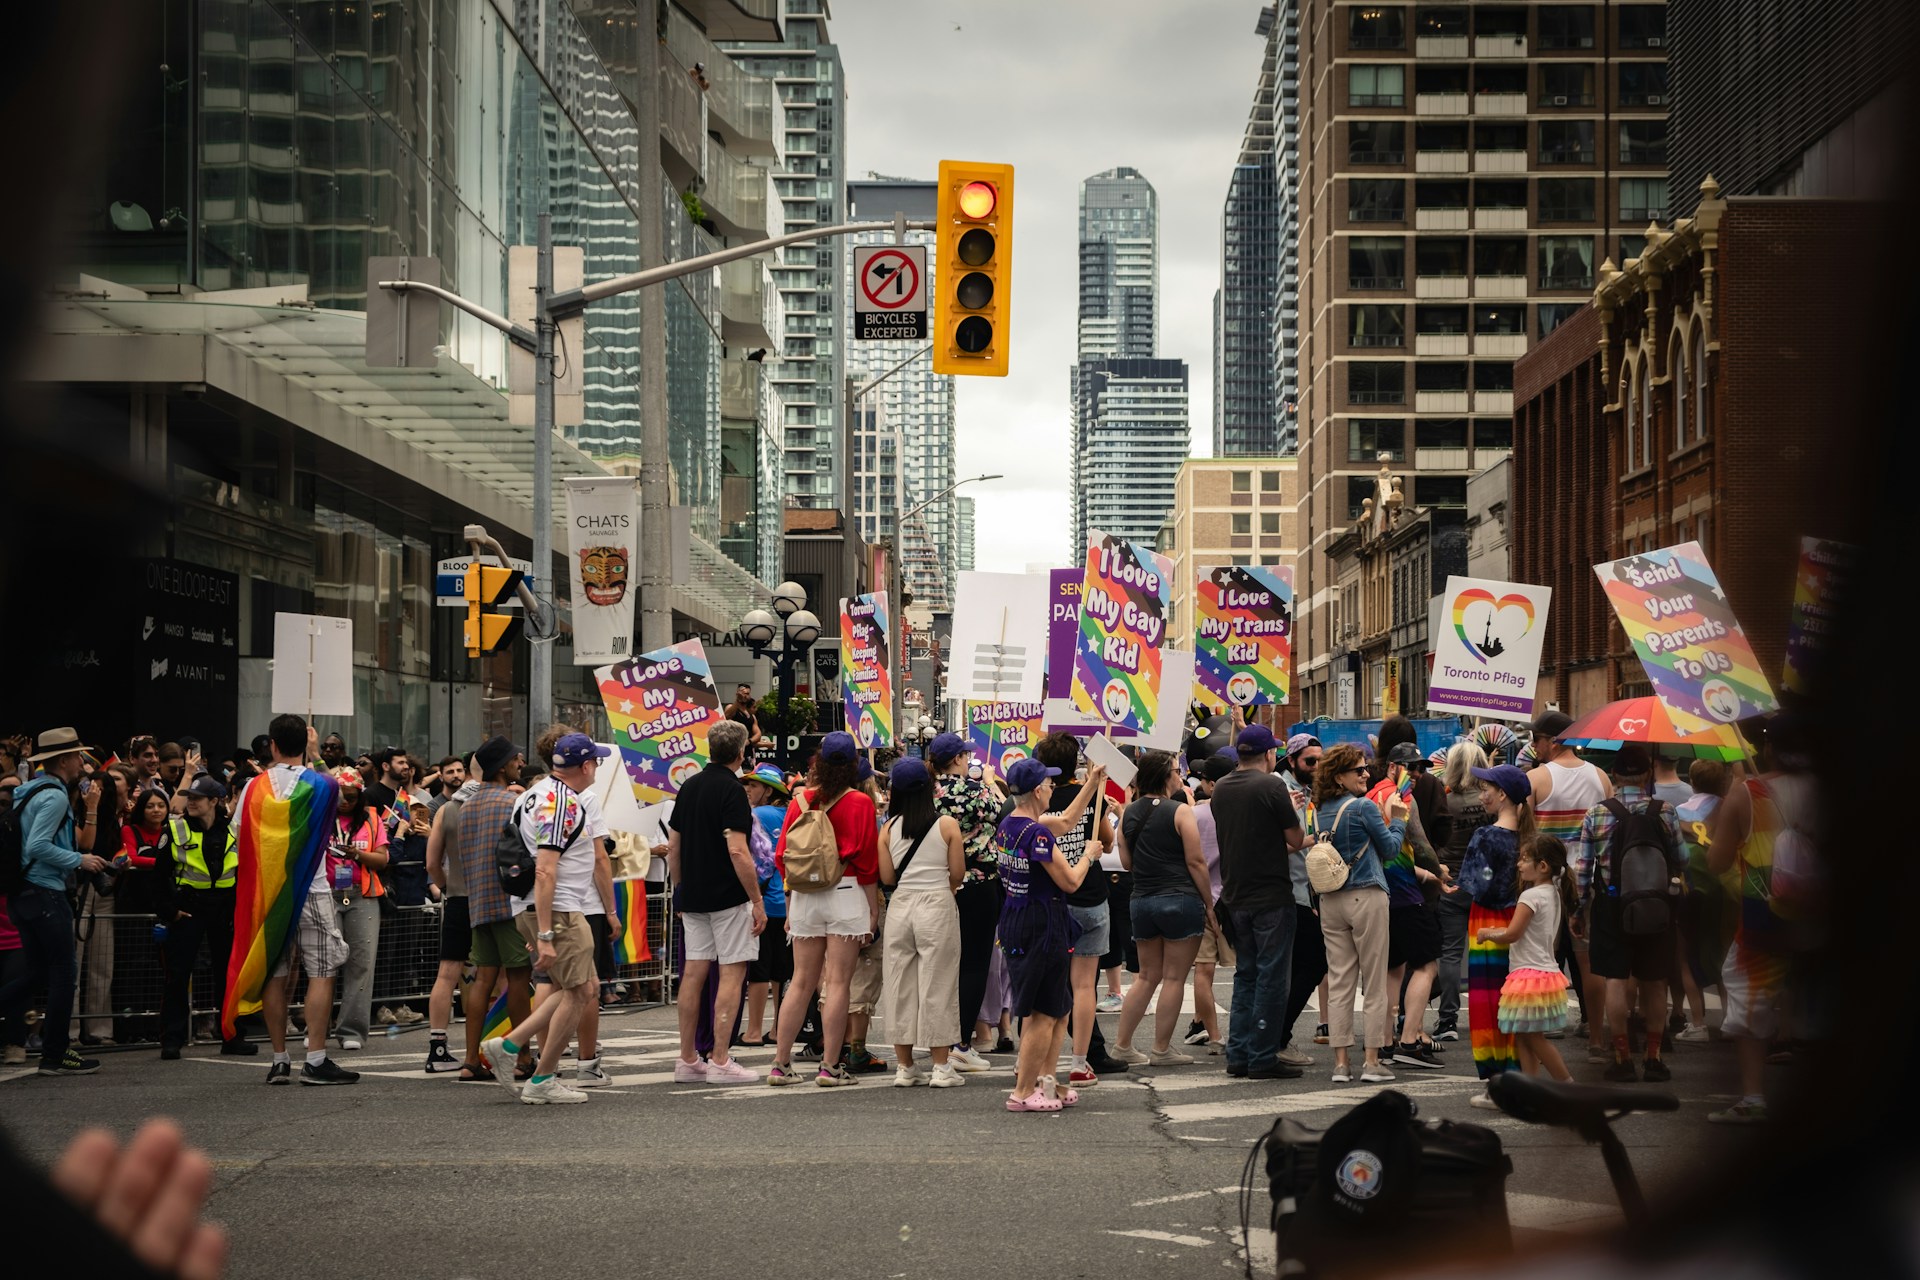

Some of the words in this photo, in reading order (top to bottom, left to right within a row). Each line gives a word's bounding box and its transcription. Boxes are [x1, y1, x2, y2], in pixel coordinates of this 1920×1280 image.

[866, 313, 917, 325] BICYCLES
[863, 327, 917, 338] EXCEPTED
[576, 514, 630, 528] CHATS
[443, 562, 469, 571] BLOO
[1099, 548, 1110, 574] I
[1111, 552, 1160, 593] Love
[1630, 558, 1682, 588] Send
[147, 561, 170, 593] ONE
[172, 567, 207, 600] BLOOR
[208, 576, 232, 605] EAST
[1060, 582, 1083, 595] SEN
[1218, 589, 1226, 607] I
[1228, 589, 1270, 607] Love
[1644, 593, 1694, 619] Your
[850, 602, 875, 617] Toronto
[1086, 586, 1120, 628] My
[1124, 601, 1161, 643] Gay
[164, 623, 184, 637] MANGO
[1201, 618, 1230, 641] My
[1233, 616, 1285, 635] Trans
[1645, 616, 1727, 653] Parents
[611, 636, 627, 655] ROM
[851, 645, 877, 663] Keeping
[1103, 637, 1139, 669] Kid
[1228, 642, 1259, 662] Kid
[175, 664, 208, 680] AVANT
[620, 669, 631, 687] I
[632, 658, 682, 683] Love
[815, 658, 838, 667] CATS
[852, 664, 878, 681] Families
[1673, 658, 1702, 679] To
[1702, 651, 1730, 671] Us
[1443, 665, 1490, 681] Toronto
[1493, 671, 1526, 688] Pflag
[642, 687, 675, 709] My
[852, 685, 881, 708] Together
[1439, 692, 1523, 709] www.torontopflag.org
[627, 705, 708, 741] Lesbian
[1000, 725, 1027, 744] Kid
[657, 733, 694, 759] Kid
